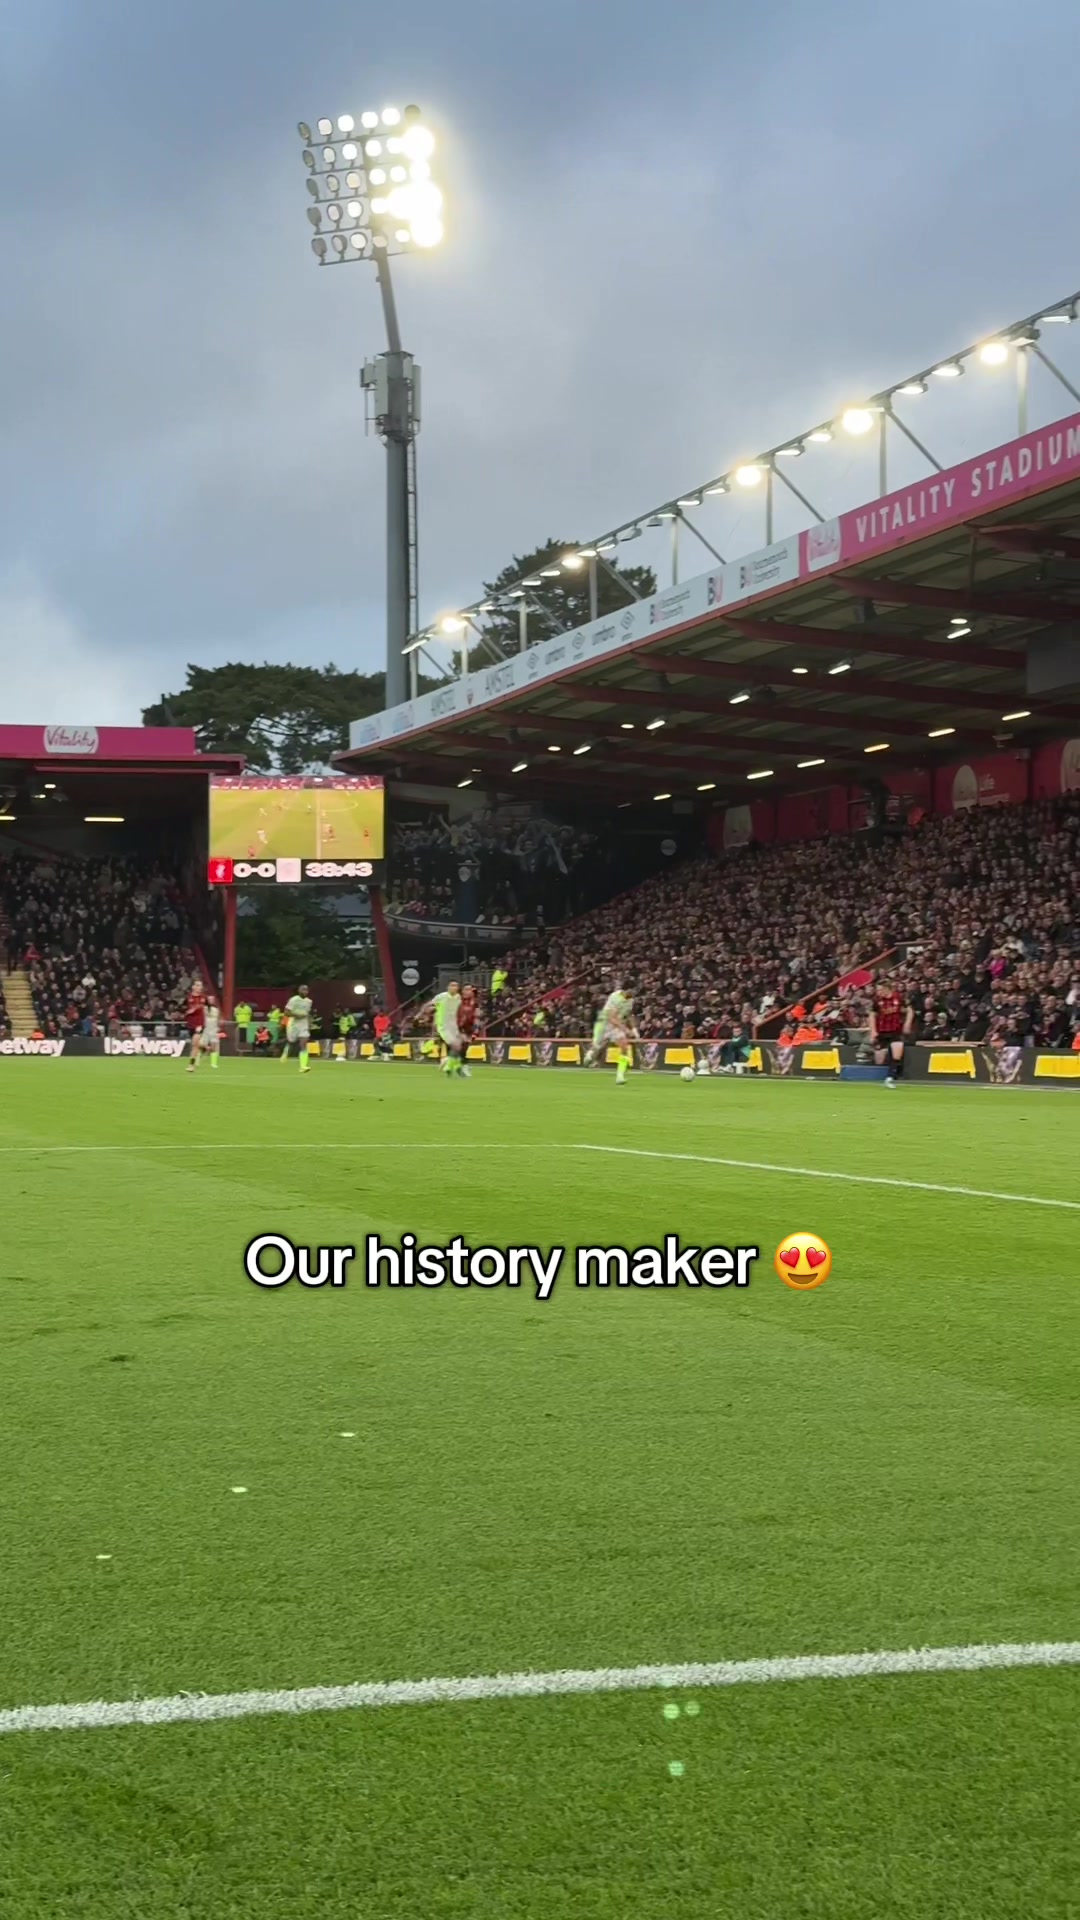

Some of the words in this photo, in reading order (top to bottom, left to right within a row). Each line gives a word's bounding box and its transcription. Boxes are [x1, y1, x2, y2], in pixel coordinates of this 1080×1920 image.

[856, 478, 956, 542] VITALITY
[971, 423, 1080, 497] STADIUM
[46, 726, 96, 754] Vitality
[233, 862, 276, 877] 0-0
[0, 1037, 66, 1057] etway
[104, 1036, 186, 1058] betway
